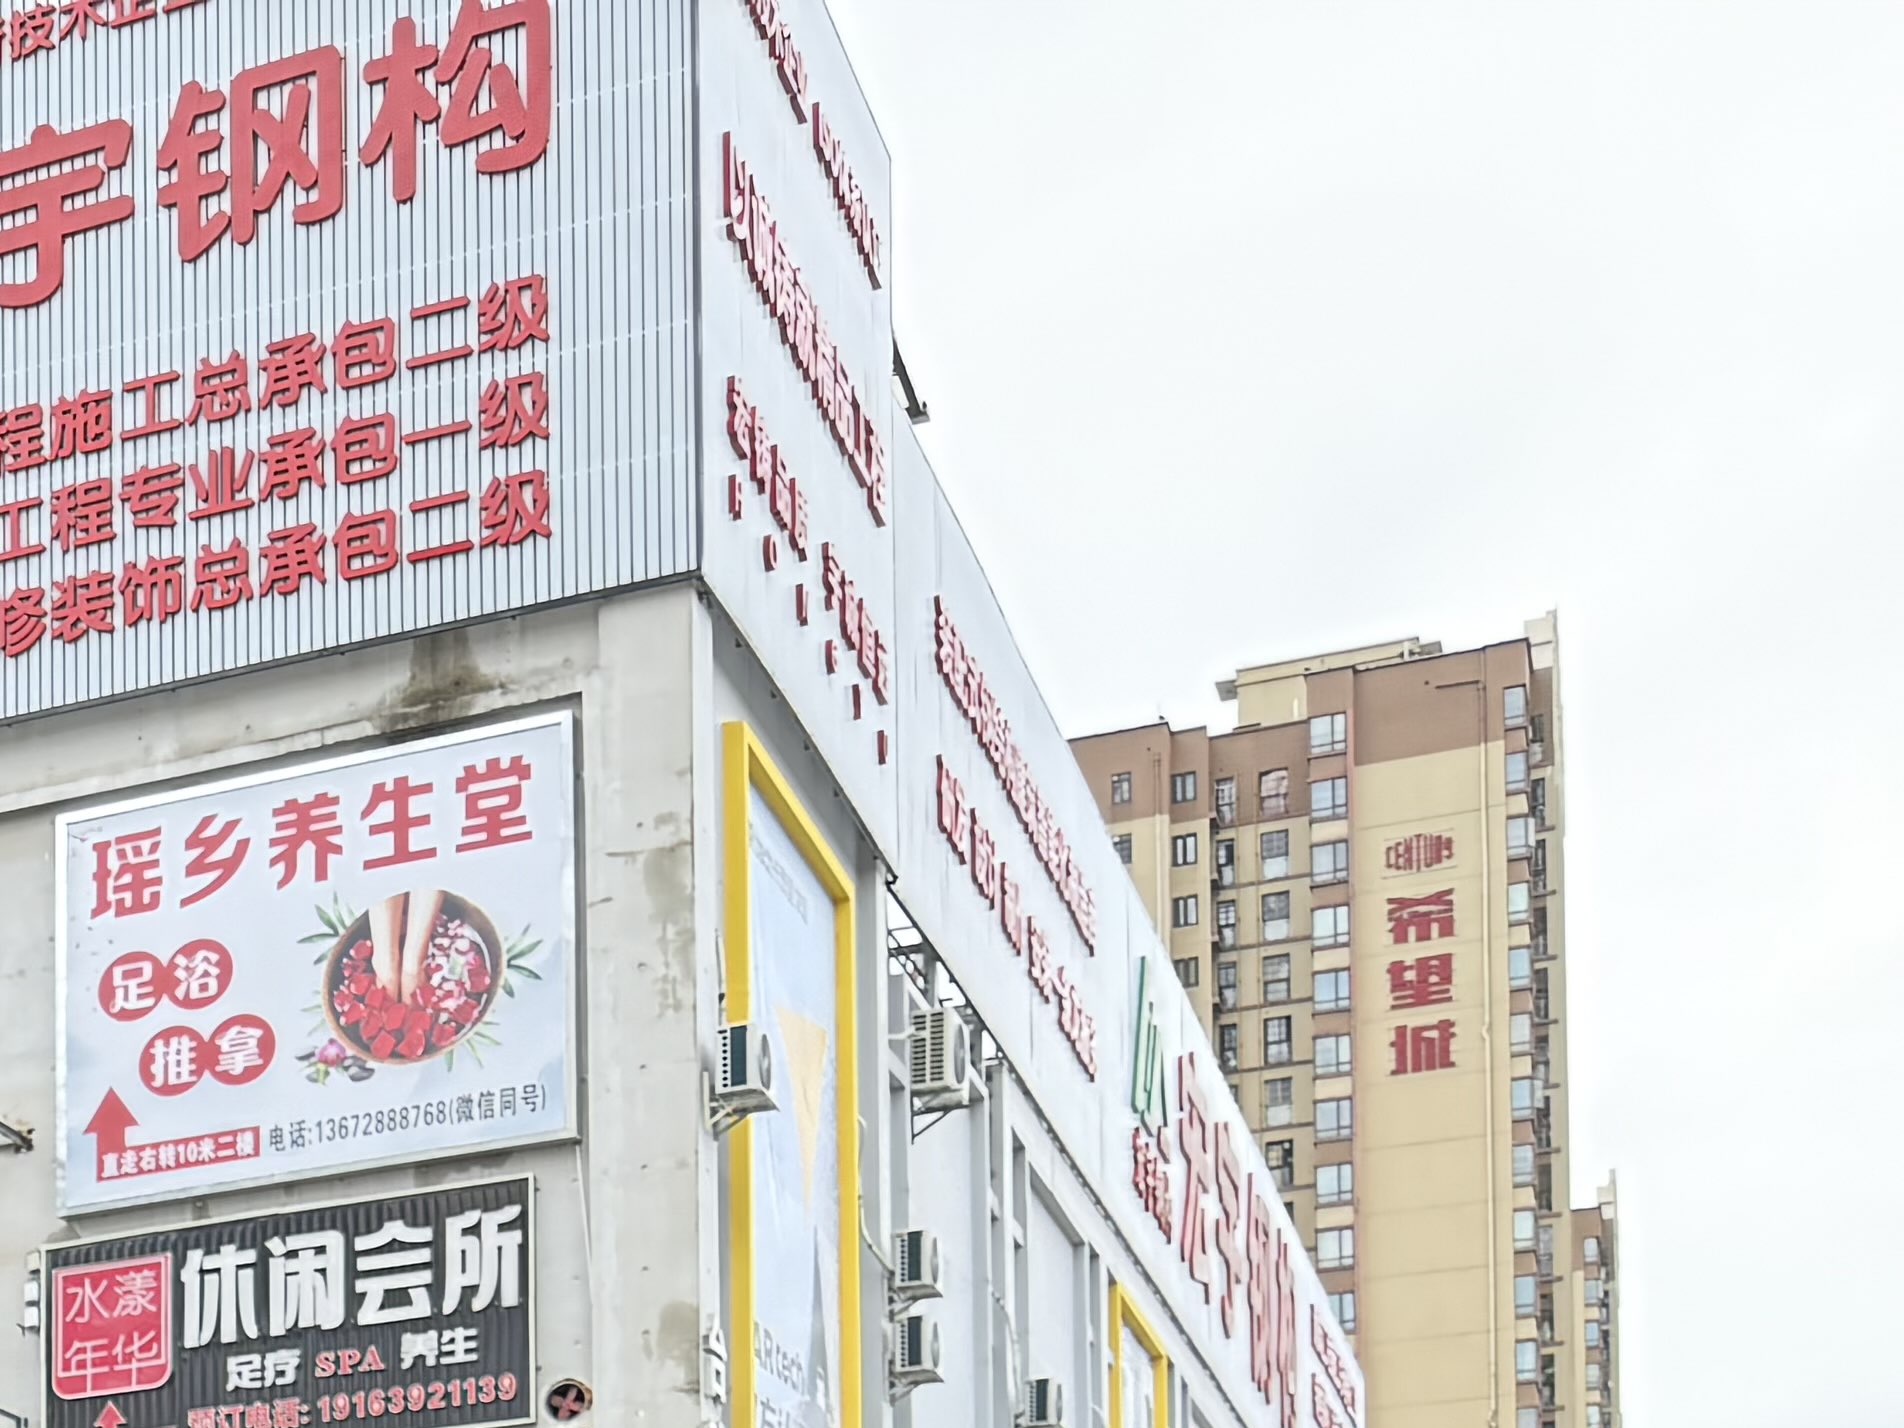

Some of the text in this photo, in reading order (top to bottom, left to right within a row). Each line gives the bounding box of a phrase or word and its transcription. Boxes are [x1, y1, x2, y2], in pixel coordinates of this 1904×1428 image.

[90, 755, 535, 919] 瑶乡养生堂
[109, 952, 222, 1015] 足浴
[1386, 887, 1457, 1077] 希望城
[149, 1025, 266, 1087] 推拿
[100, 1133, 257, 1178] 直走右转10米二楼
[180, 1203, 523, 1349] 休闲会所
[64, 1330, 160, 1392] 年华
[225, 1327, 480, 1392] 足疗 SPA 养生
